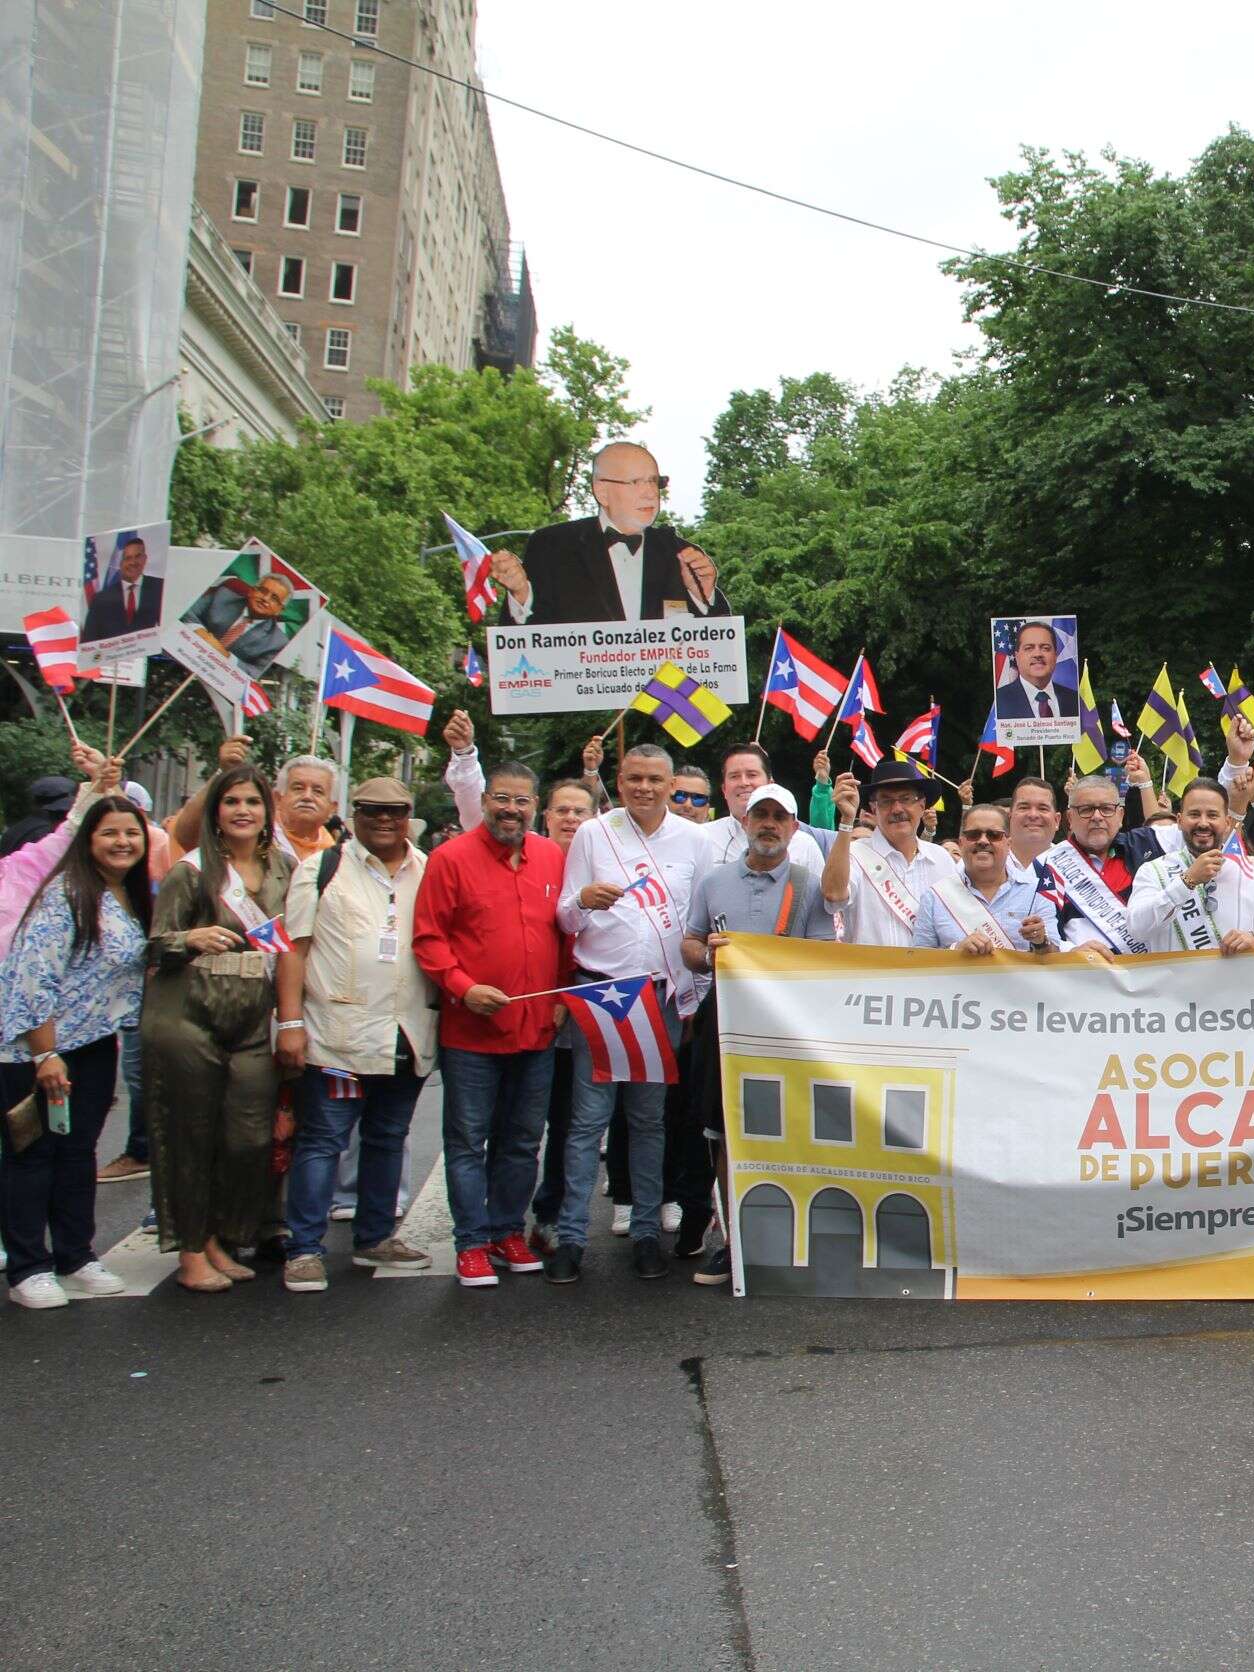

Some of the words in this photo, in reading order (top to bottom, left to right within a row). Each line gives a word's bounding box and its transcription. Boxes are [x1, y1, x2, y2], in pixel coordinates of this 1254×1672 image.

[496, 634, 526, 650] Don
[531, 630, 587, 648] Ramón
[592, 627, 667, 646] González
[671, 625, 736, 643] Cordero
[579, 648, 636, 664] Fundador
[686, 646, 710, 659] Gas
[554, 668, 583, 681] Primer
[585, 667, 618, 679] Boricua
[620, 665, 646, 677] Electo
[686, 663, 697, 674] de
[700, 662, 711, 673] La
[713, 661, 737, 673] Fama
[499, 679, 552, 690] EMPIRE
[511, 689, 542, 698] GAS
[576, 684, 594, 695] Gas
[597, 682, 633, 694] Licuado
[1050, 850, 1085, 884] ALCALDE
[1073, 876, 1115, 918] MUNICIPIO
[1106, 911, 1125, 928] DE
[1181, 897, 1201, 922] DE
[902, 992, 982, 1031] PAÍS
[989, 1007, 1028, 1033] se
[1036, 1001, 1167, 1034] levanta
[796, 1165, 808, 1173] DE
[810, 1166, 854, 1178] ALCALDES
[856, 1170, 868, 1178] DE
[870, 1171, 905, 1182] PUERTO
[908, 1175, 930, 1184] RICO
[1079, 1153, 1120, 1183] DE
